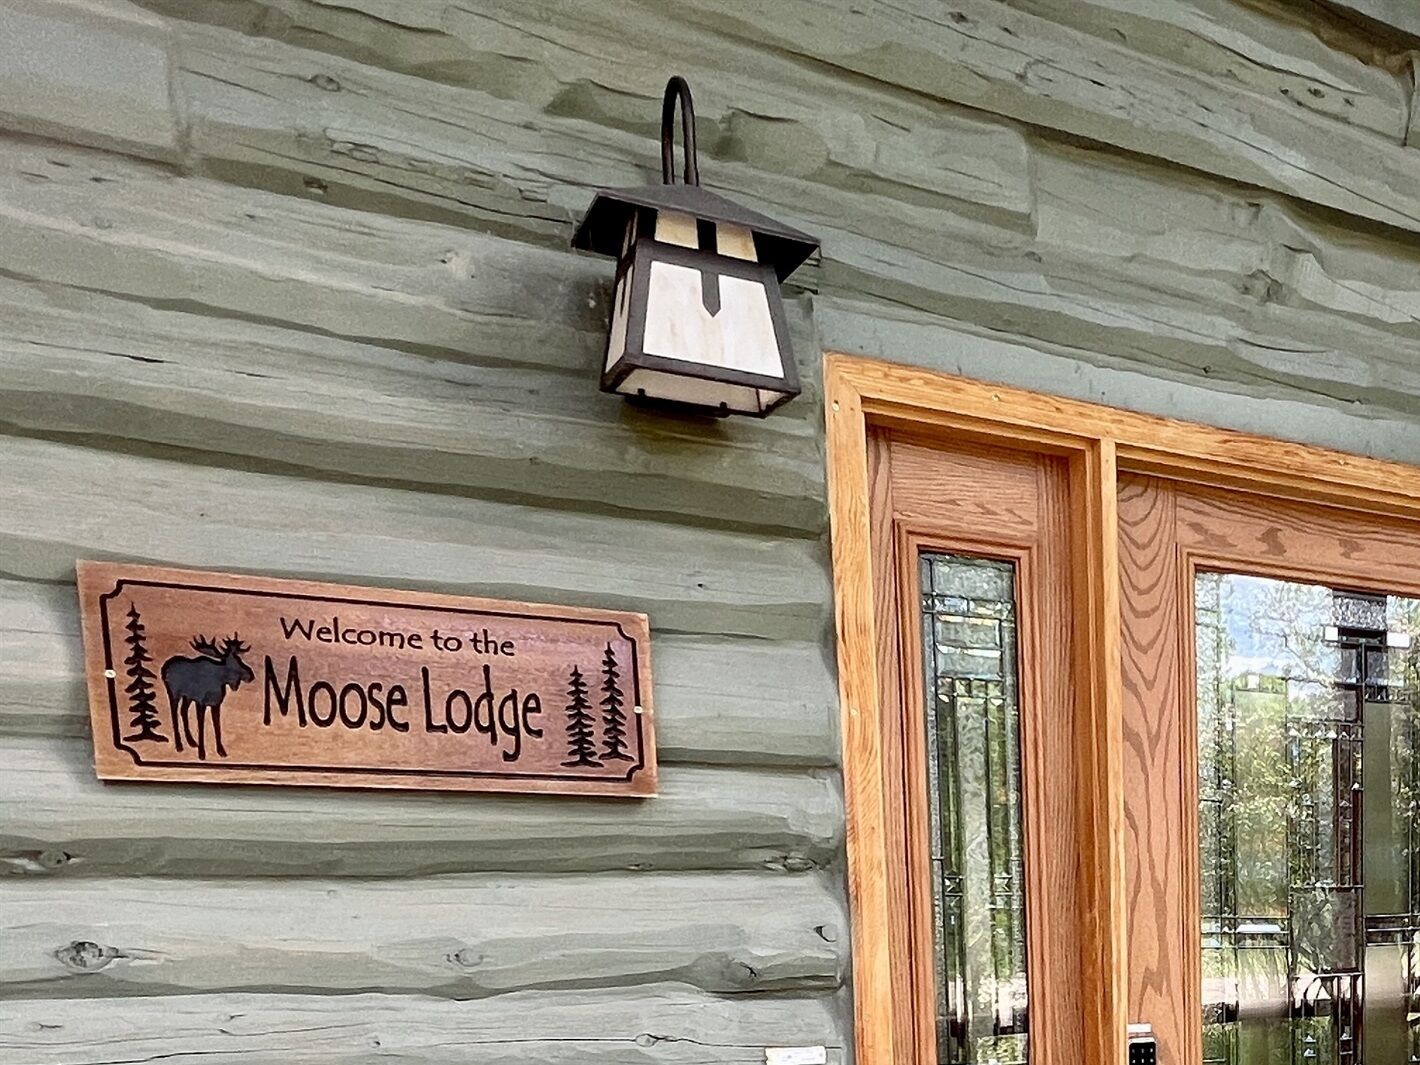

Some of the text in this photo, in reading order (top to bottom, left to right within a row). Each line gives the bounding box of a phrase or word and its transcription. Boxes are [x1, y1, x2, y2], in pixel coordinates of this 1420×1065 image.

[279, 616, 515, 657] Welcome to the
[263, 654, 544, 763] Moose Lodge
